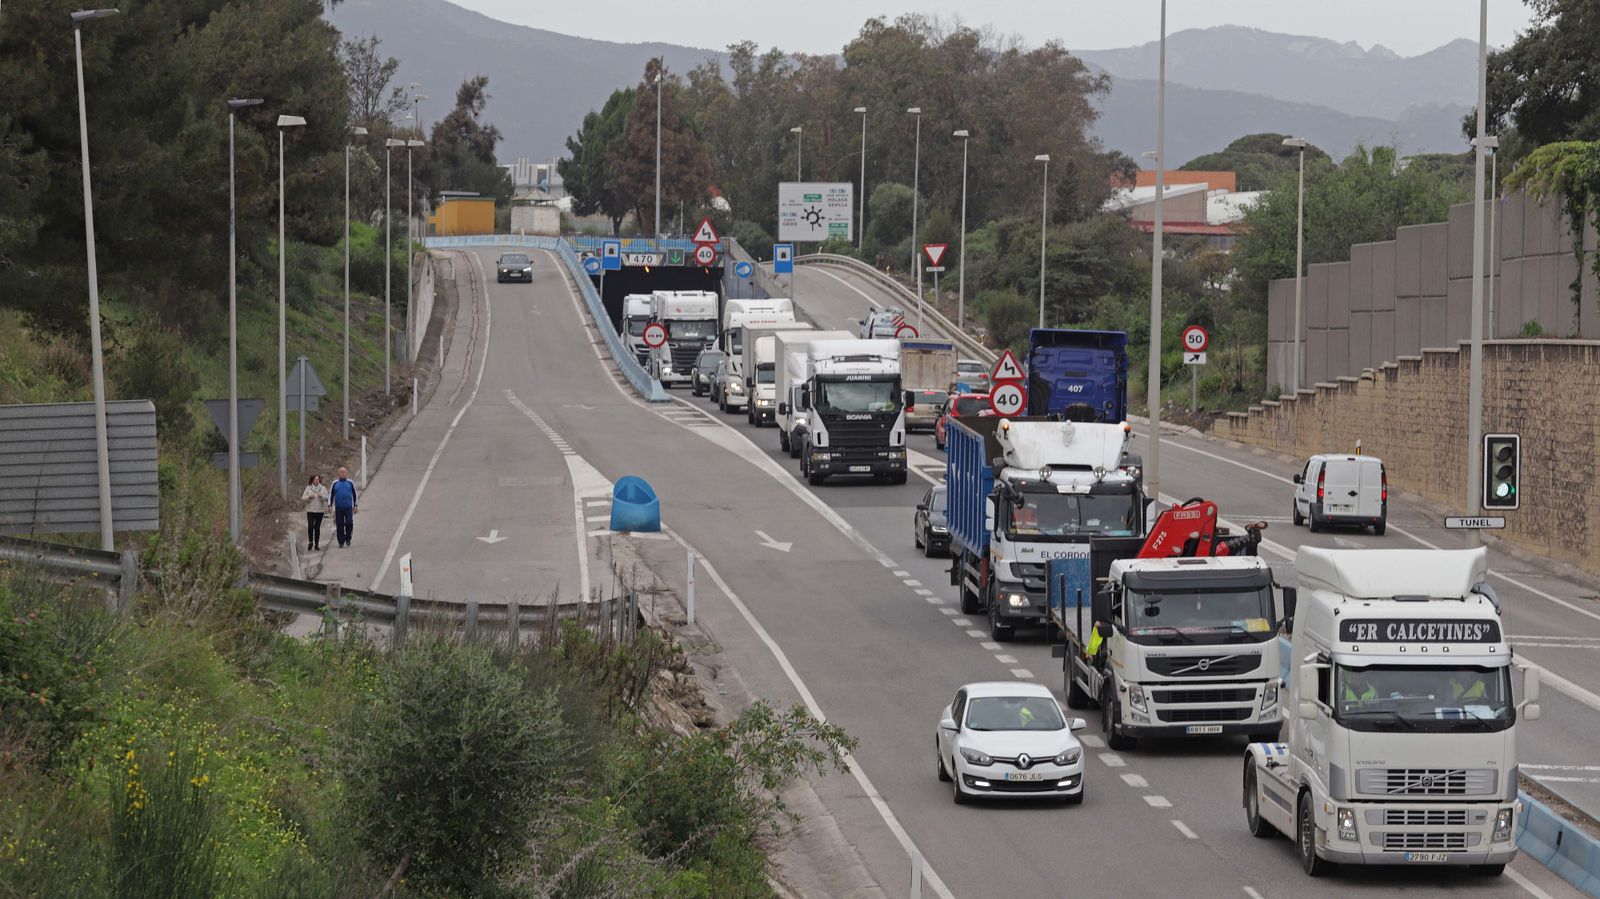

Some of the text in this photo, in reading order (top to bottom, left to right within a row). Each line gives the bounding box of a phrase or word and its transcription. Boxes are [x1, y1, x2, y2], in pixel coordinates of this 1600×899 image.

[1188, 334, 1203, 344] 50
[1067, 385, 1084, 393] 407
[996, 394, 1019, 406] 40
[1152, 530, 1168, 550] F275
[1040, 551, 1051, 559] EL
